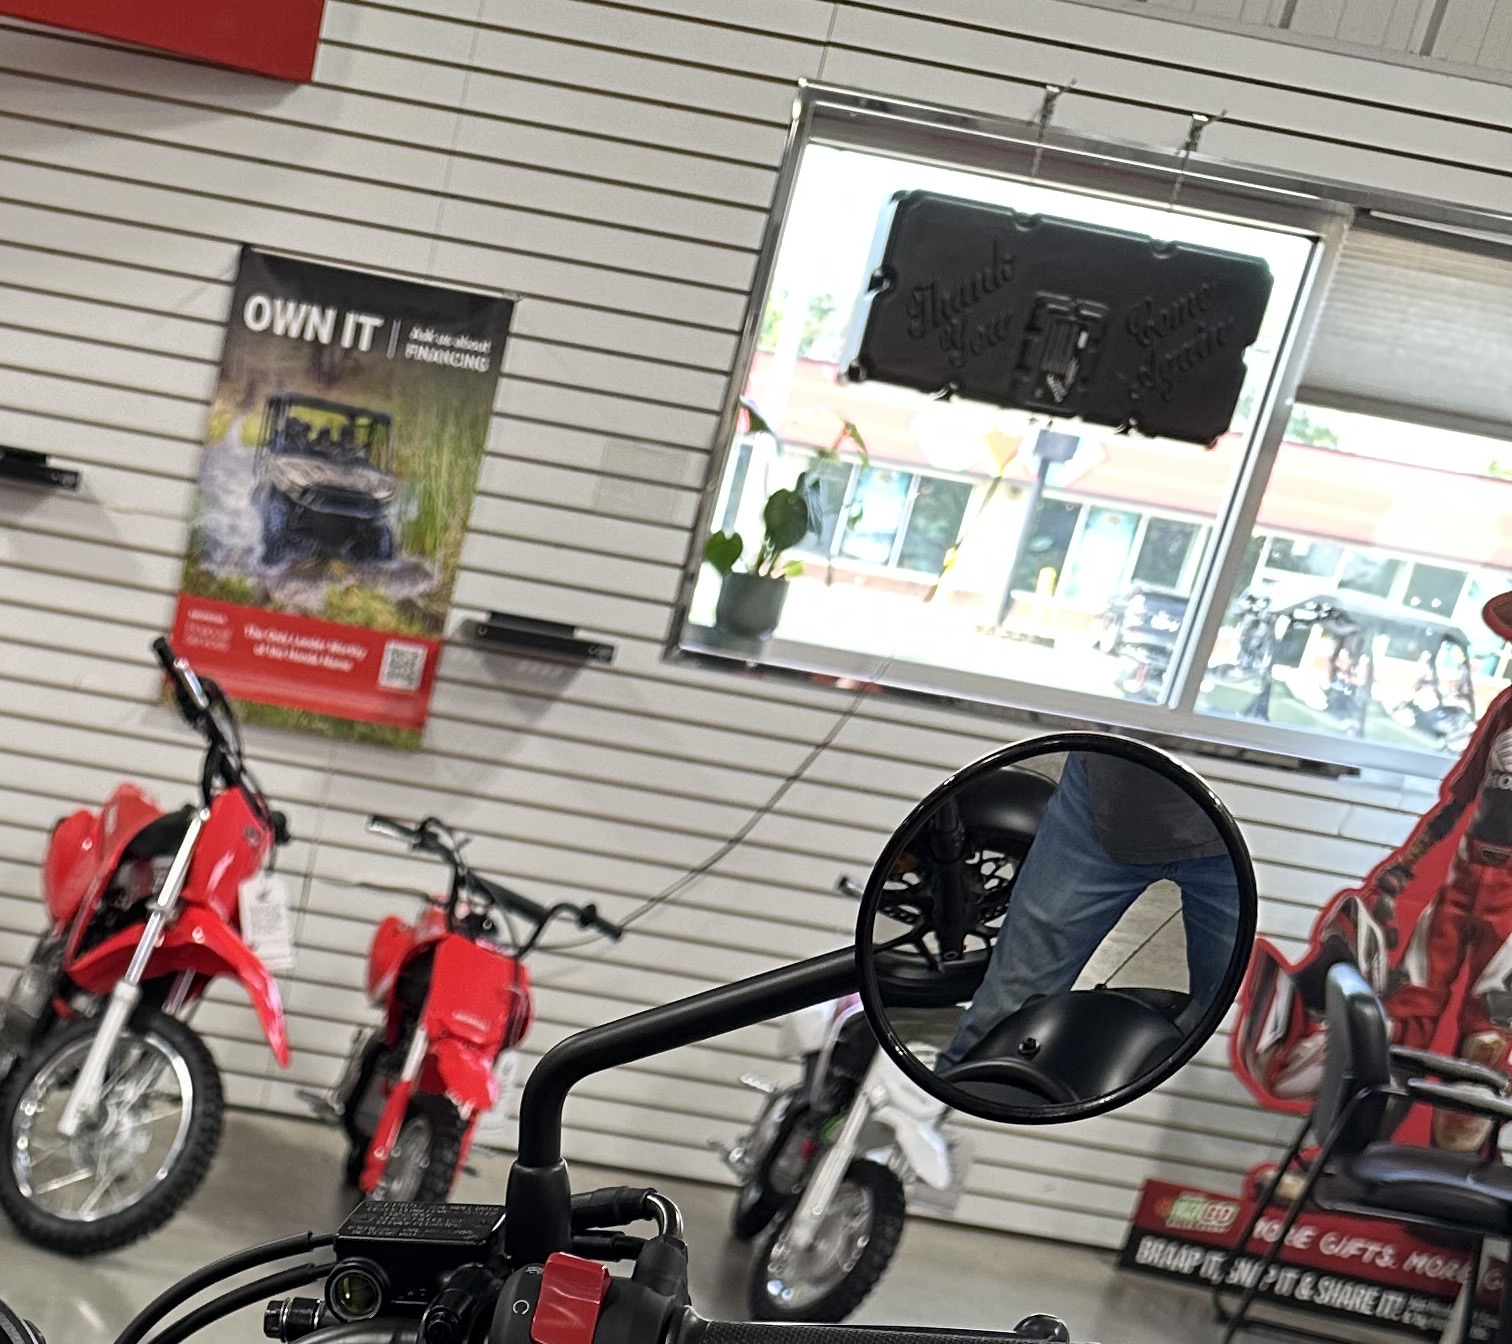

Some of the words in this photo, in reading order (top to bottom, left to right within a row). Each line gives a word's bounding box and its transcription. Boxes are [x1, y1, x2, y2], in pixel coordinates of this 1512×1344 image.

[243, 293, 337, 345] OWN
[340, 311, 385, 352] IT
[405, 342, 490, 373] FINANCING
[1136, 1234, 1203, 1274] BRAAP
[1225, 1256, 1276, 1292] SNP
[1273, 1265, 1301, 1295] IT
[1294, 1271, 1317, 1301] &
[1312, 1274, 1380, 1317] SHARE
